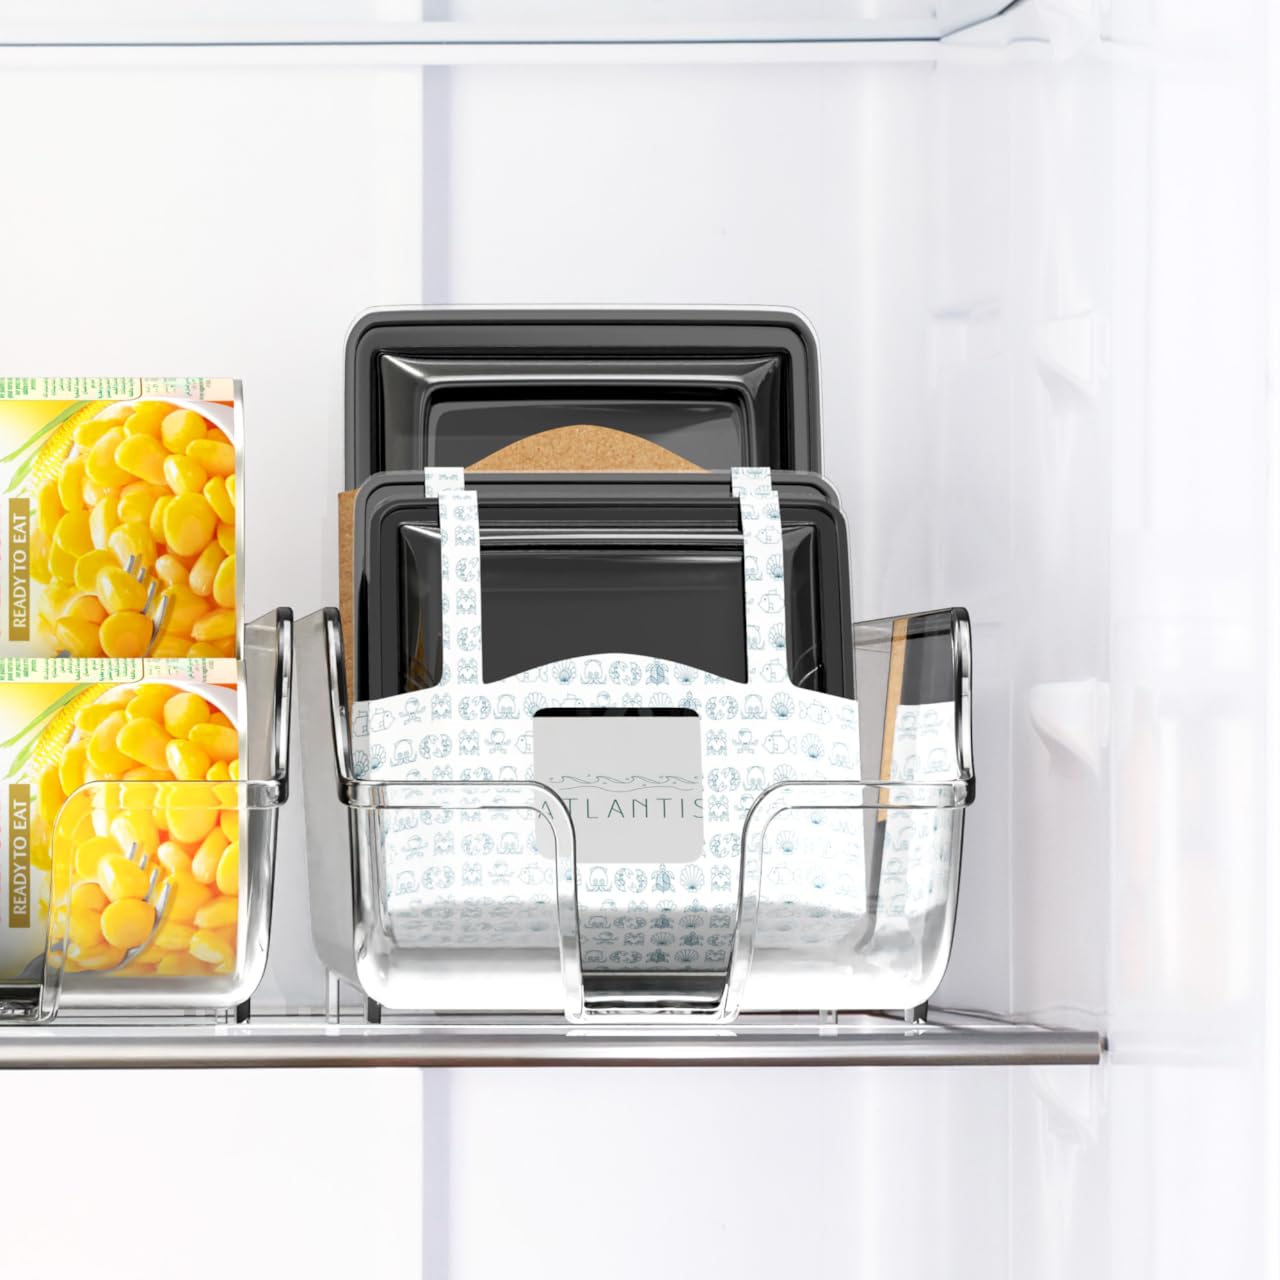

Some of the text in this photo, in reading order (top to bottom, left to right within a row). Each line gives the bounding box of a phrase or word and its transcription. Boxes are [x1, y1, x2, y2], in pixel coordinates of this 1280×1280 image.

[11, 512, 29, 629] READY TO EAT
[11, 798, 29, 916] READY TO EAT
